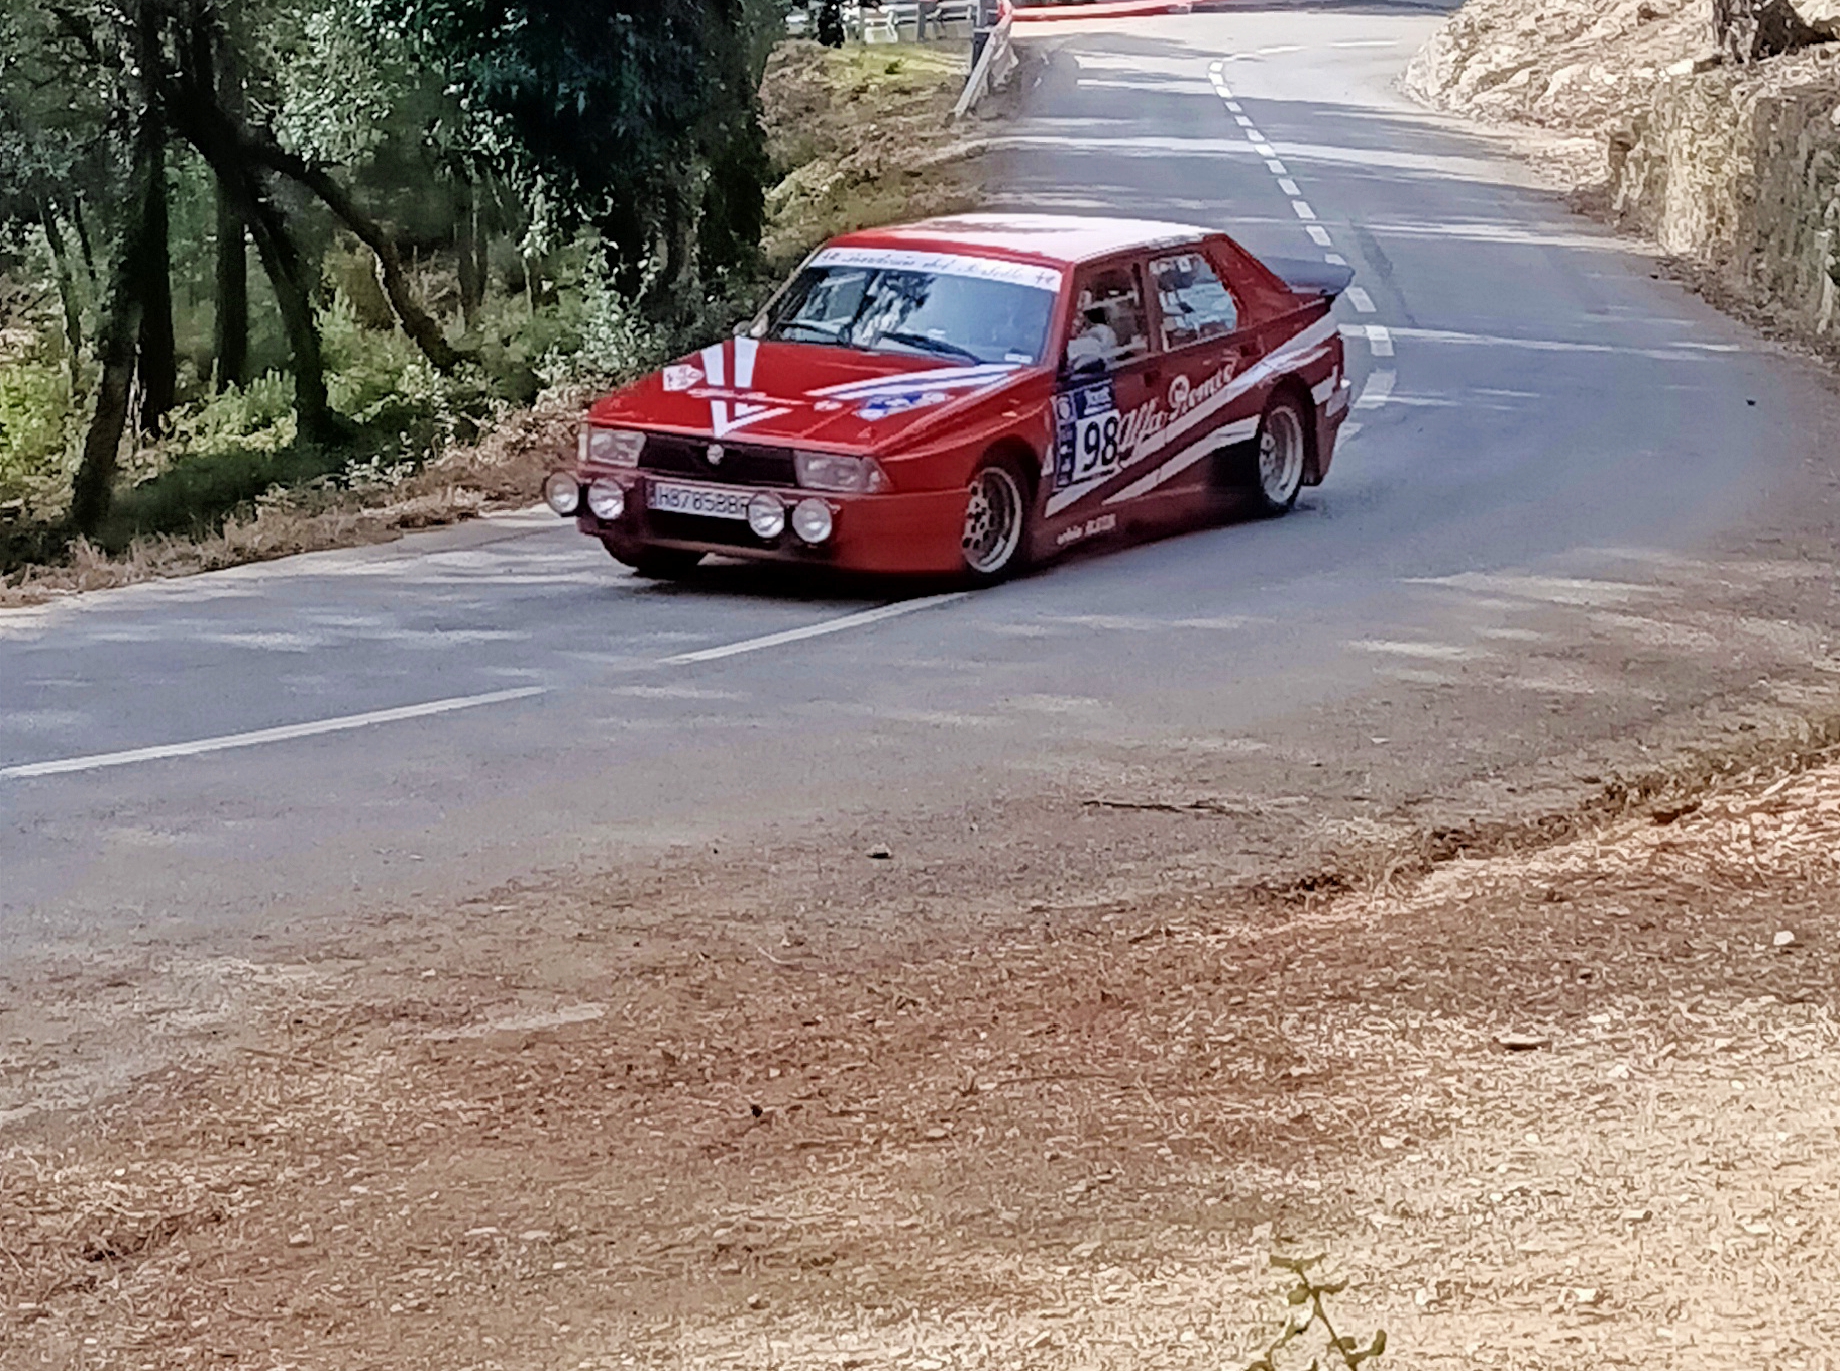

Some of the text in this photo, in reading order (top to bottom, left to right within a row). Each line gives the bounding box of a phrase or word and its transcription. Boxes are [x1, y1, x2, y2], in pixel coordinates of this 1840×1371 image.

[1083, 416, 1118, 473] 98
[1117, 397, 1169, 467] Alfa
[1168, 357, 1238, 422] Romeo
